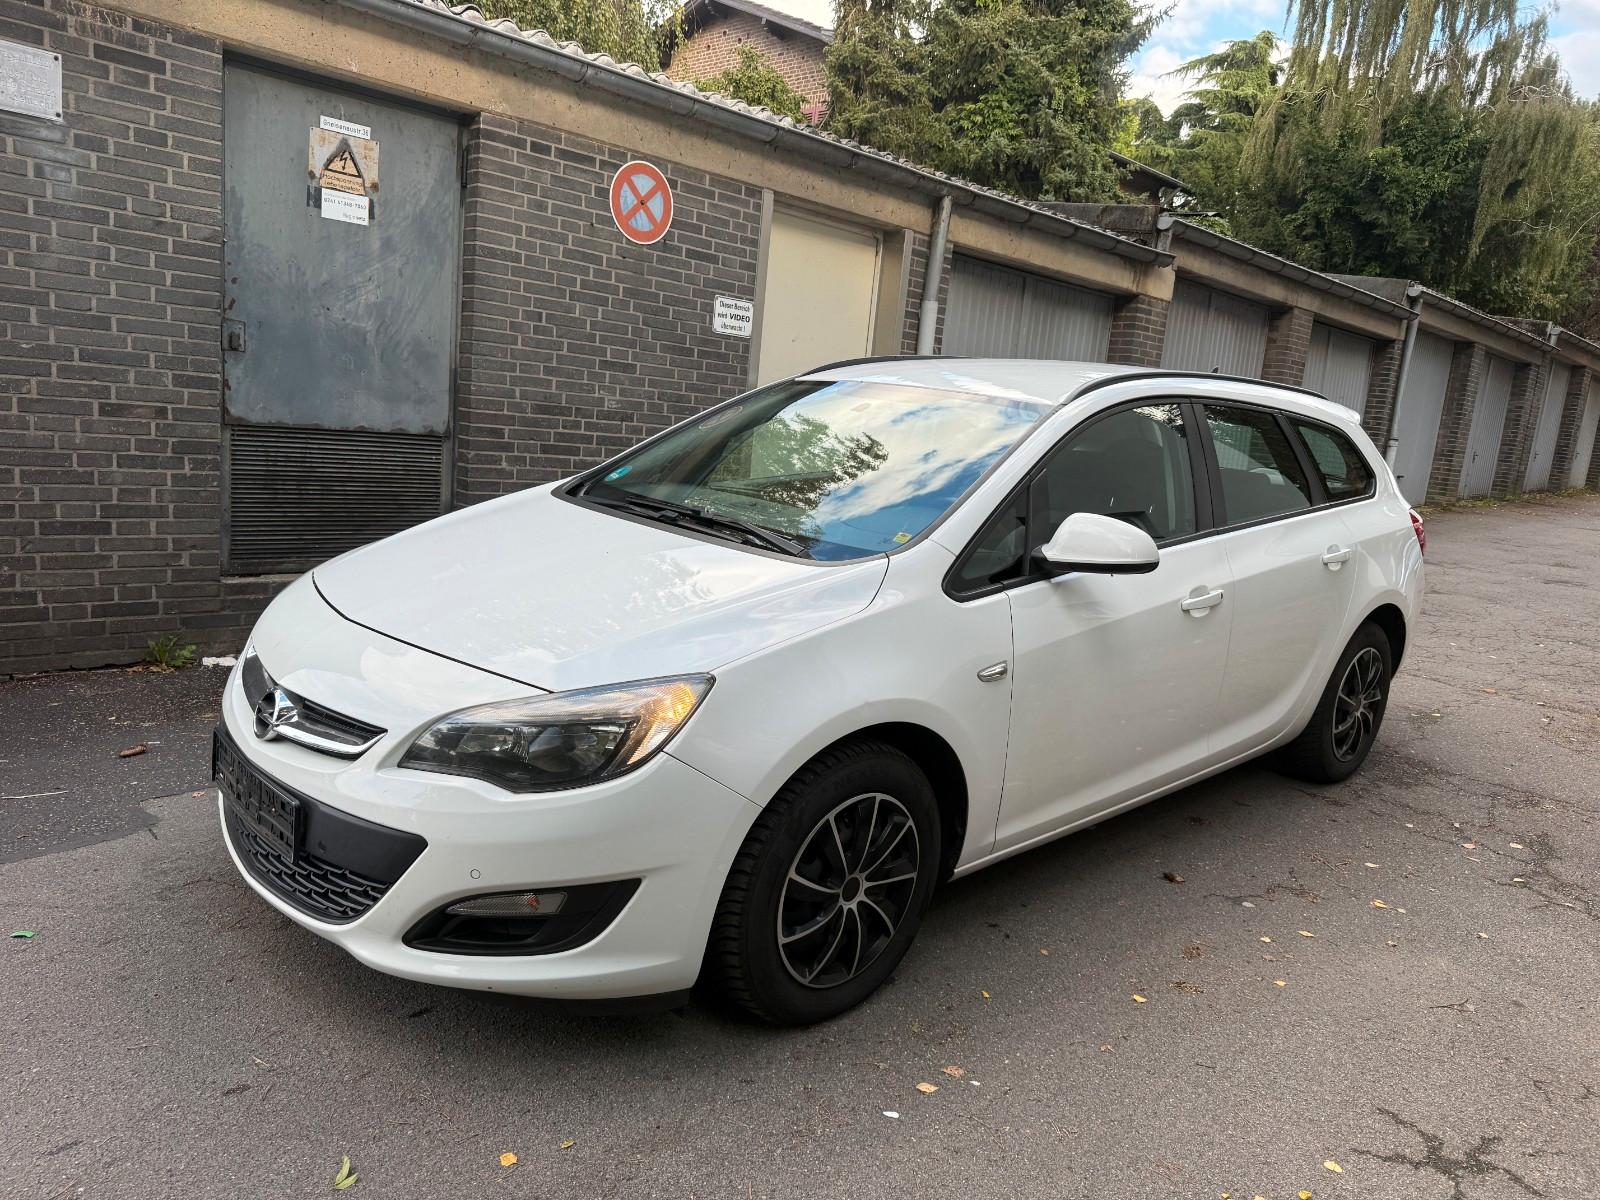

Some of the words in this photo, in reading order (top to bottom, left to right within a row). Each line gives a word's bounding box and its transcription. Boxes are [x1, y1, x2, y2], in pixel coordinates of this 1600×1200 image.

[720, 300, 734, 309] Dieser
[734, 303, 750, 312] Bereich
[717, 311, 728, 319] wird
[729, 312, 751, 323] VIDEO
